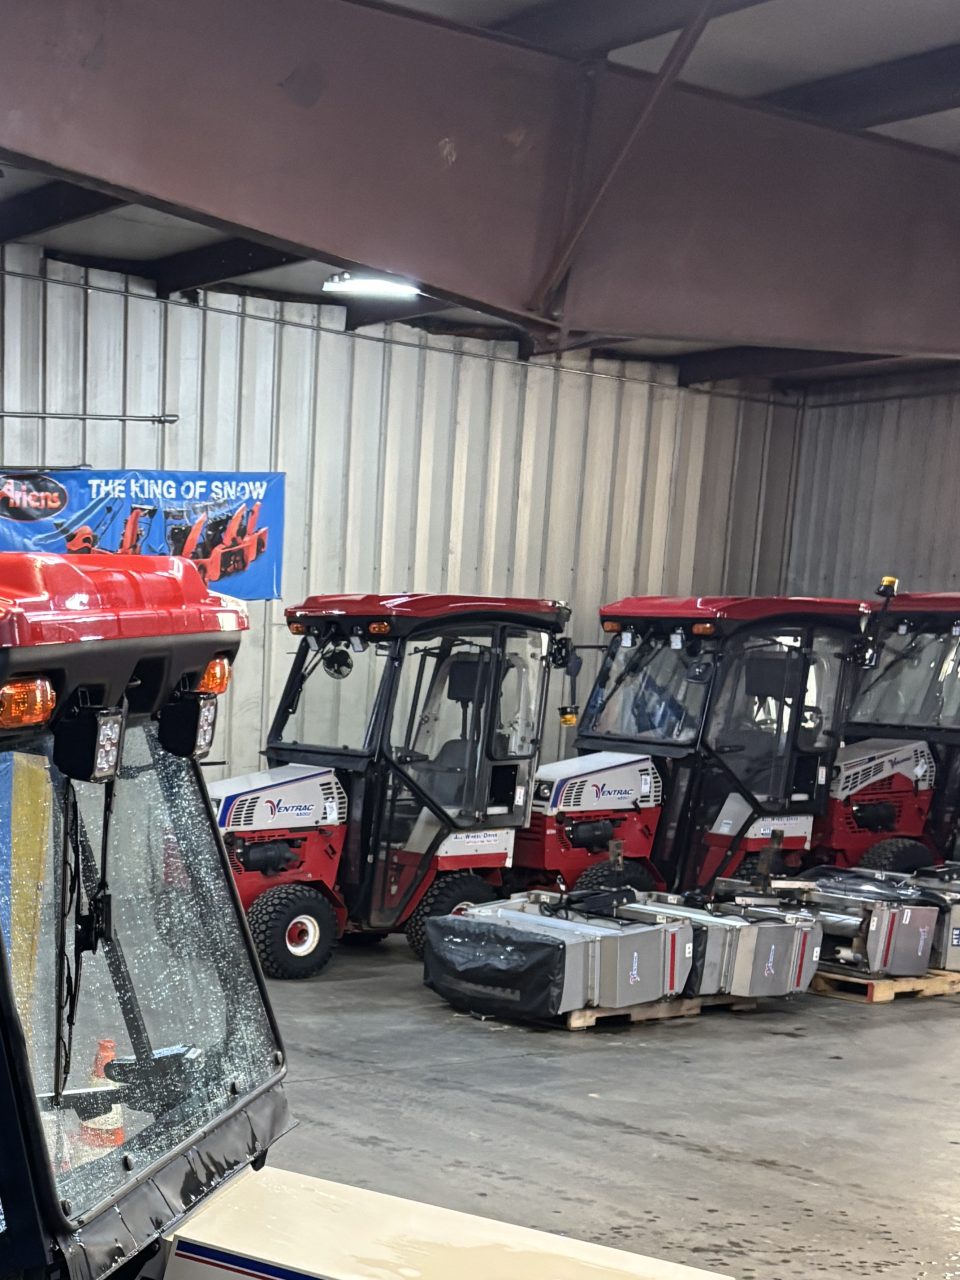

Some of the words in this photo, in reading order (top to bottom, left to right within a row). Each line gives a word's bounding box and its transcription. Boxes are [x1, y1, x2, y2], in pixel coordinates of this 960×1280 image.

[88, 479, 126, 499] THE
[131, 479, 176, 499] KING
[180, 480, 207, 500] OF
[211, 480, 267, 500] SNOW
[592, 783, 634, 801] VENTRAC
[265, 799, 314, 820] VENTRAC
